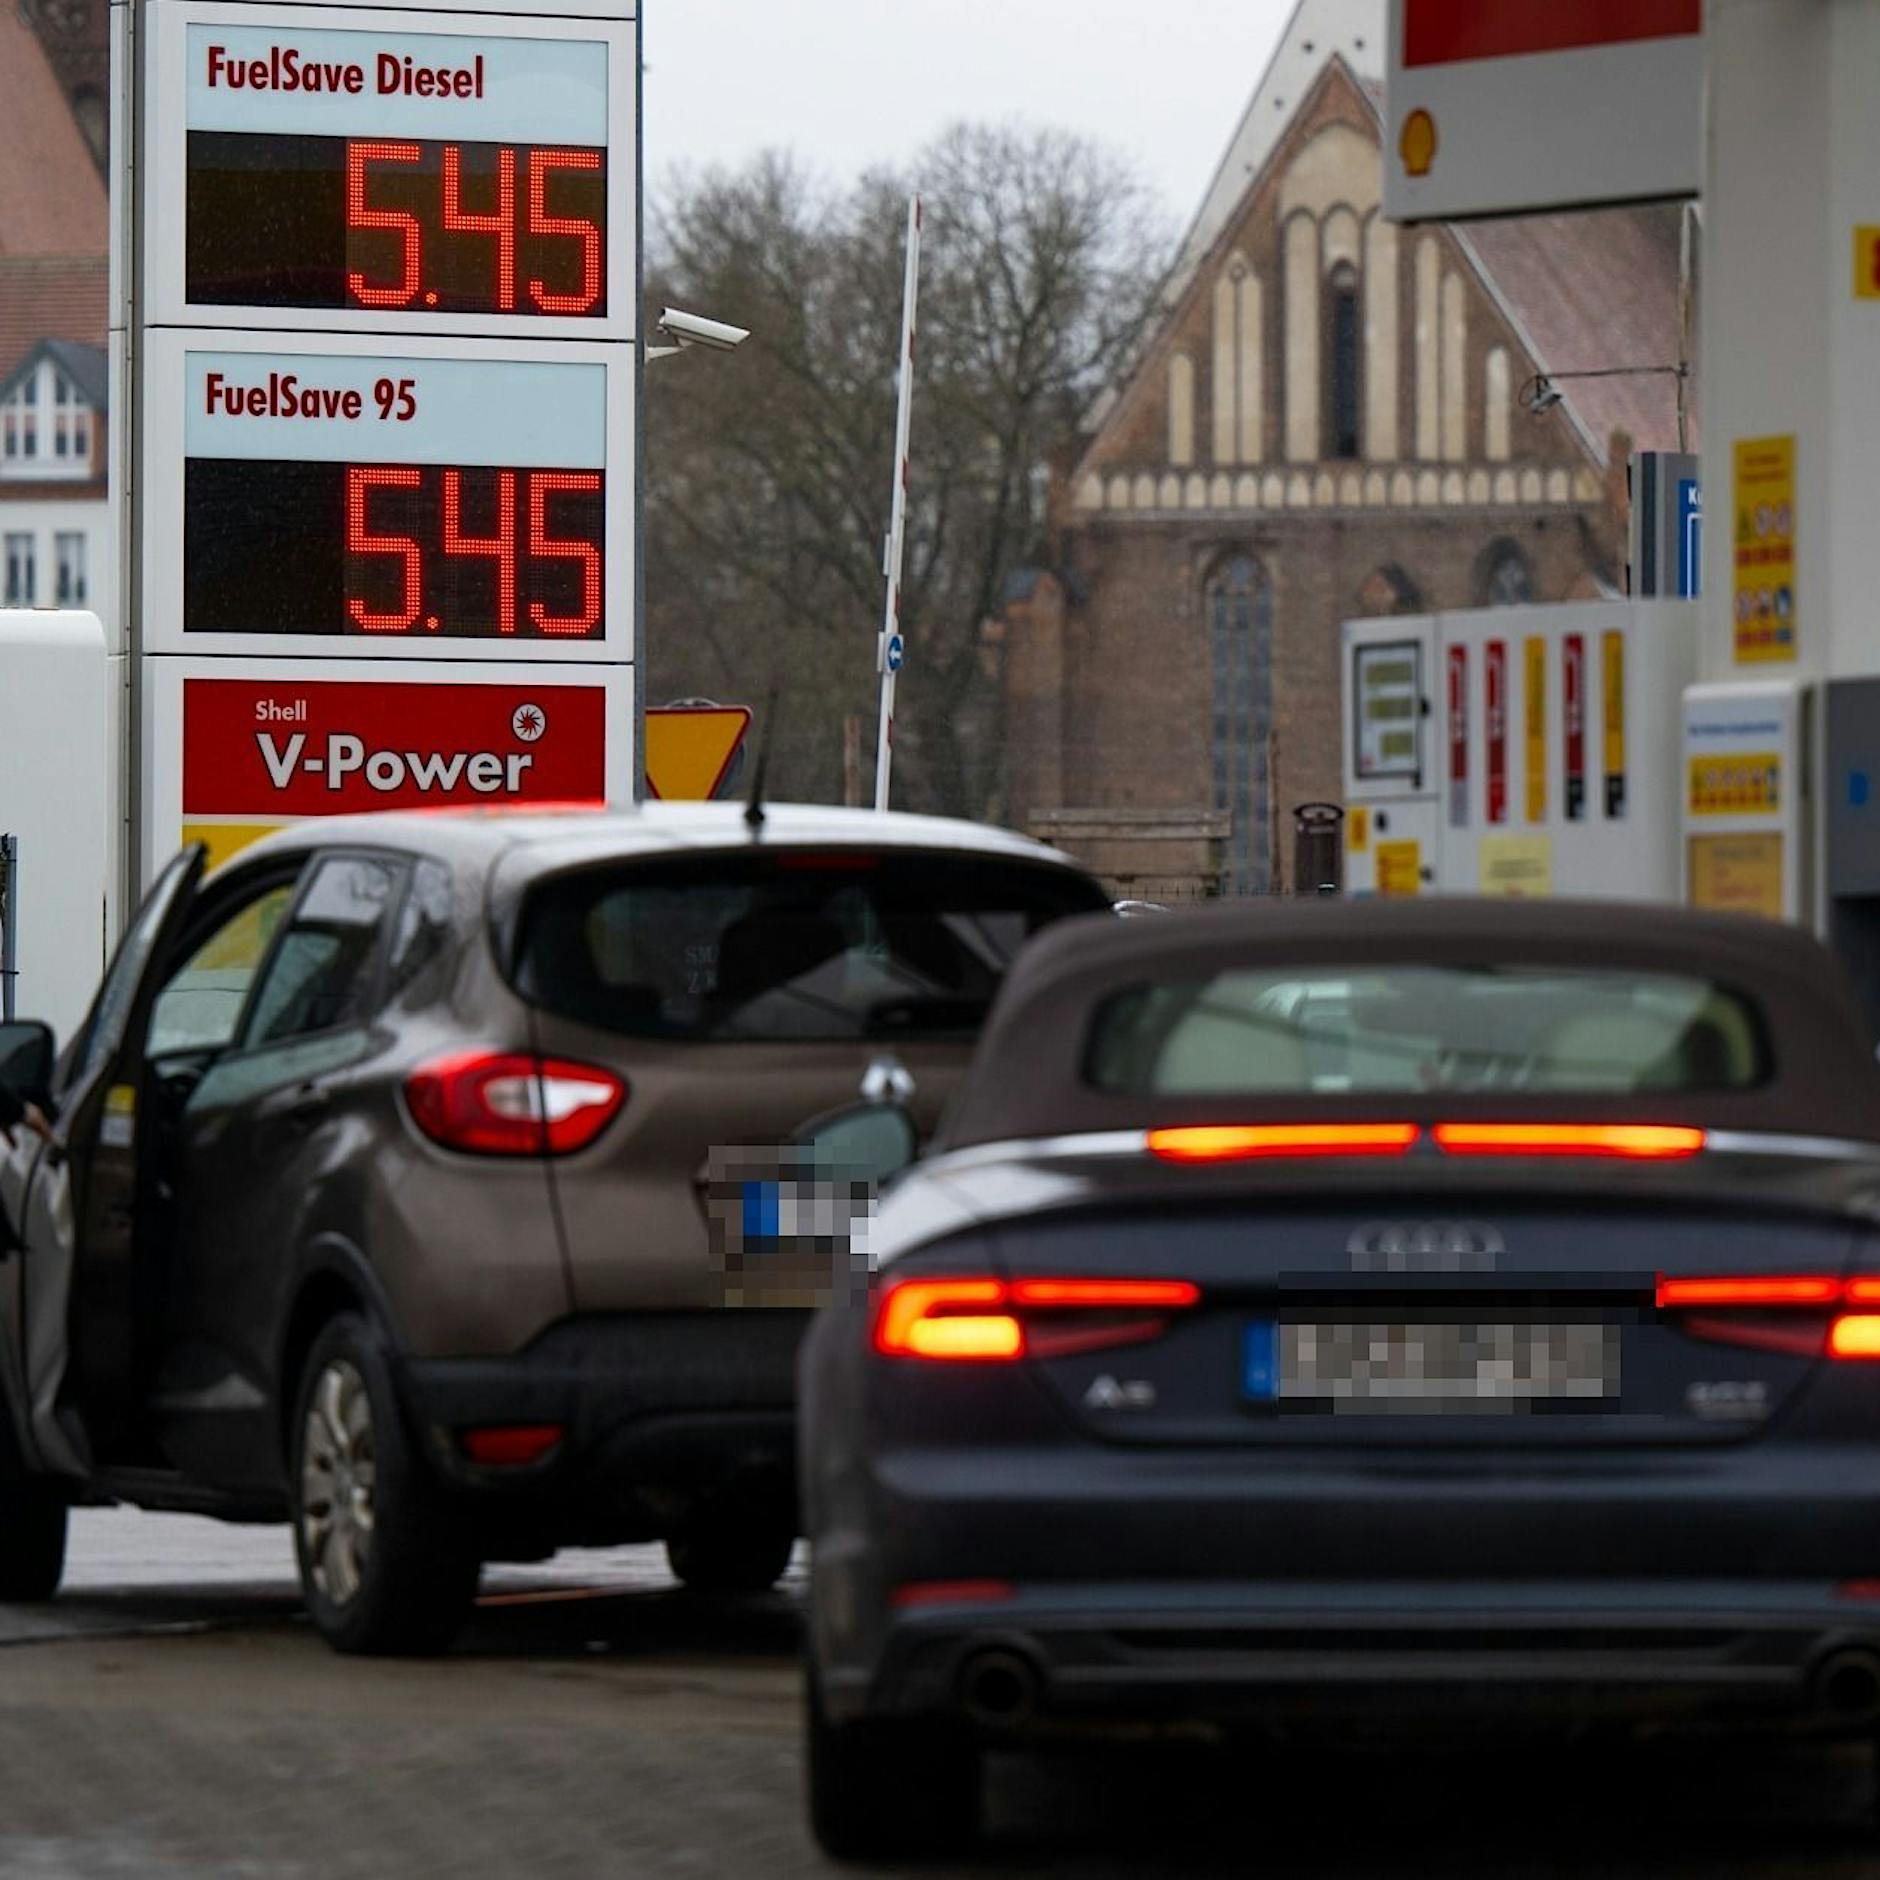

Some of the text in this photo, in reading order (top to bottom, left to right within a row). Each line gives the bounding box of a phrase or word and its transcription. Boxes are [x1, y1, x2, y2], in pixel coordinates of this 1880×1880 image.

[207, 46, 484, 99] FuelSave Diesel
[347, 142, 601, 313] 5.45
[206, 373, 417, 422] FuelSave 95
[348, 467, 601, 634] 5.45
[255, 699, 307, 722] Shell
[256, 732, 533, 793] V-Power
